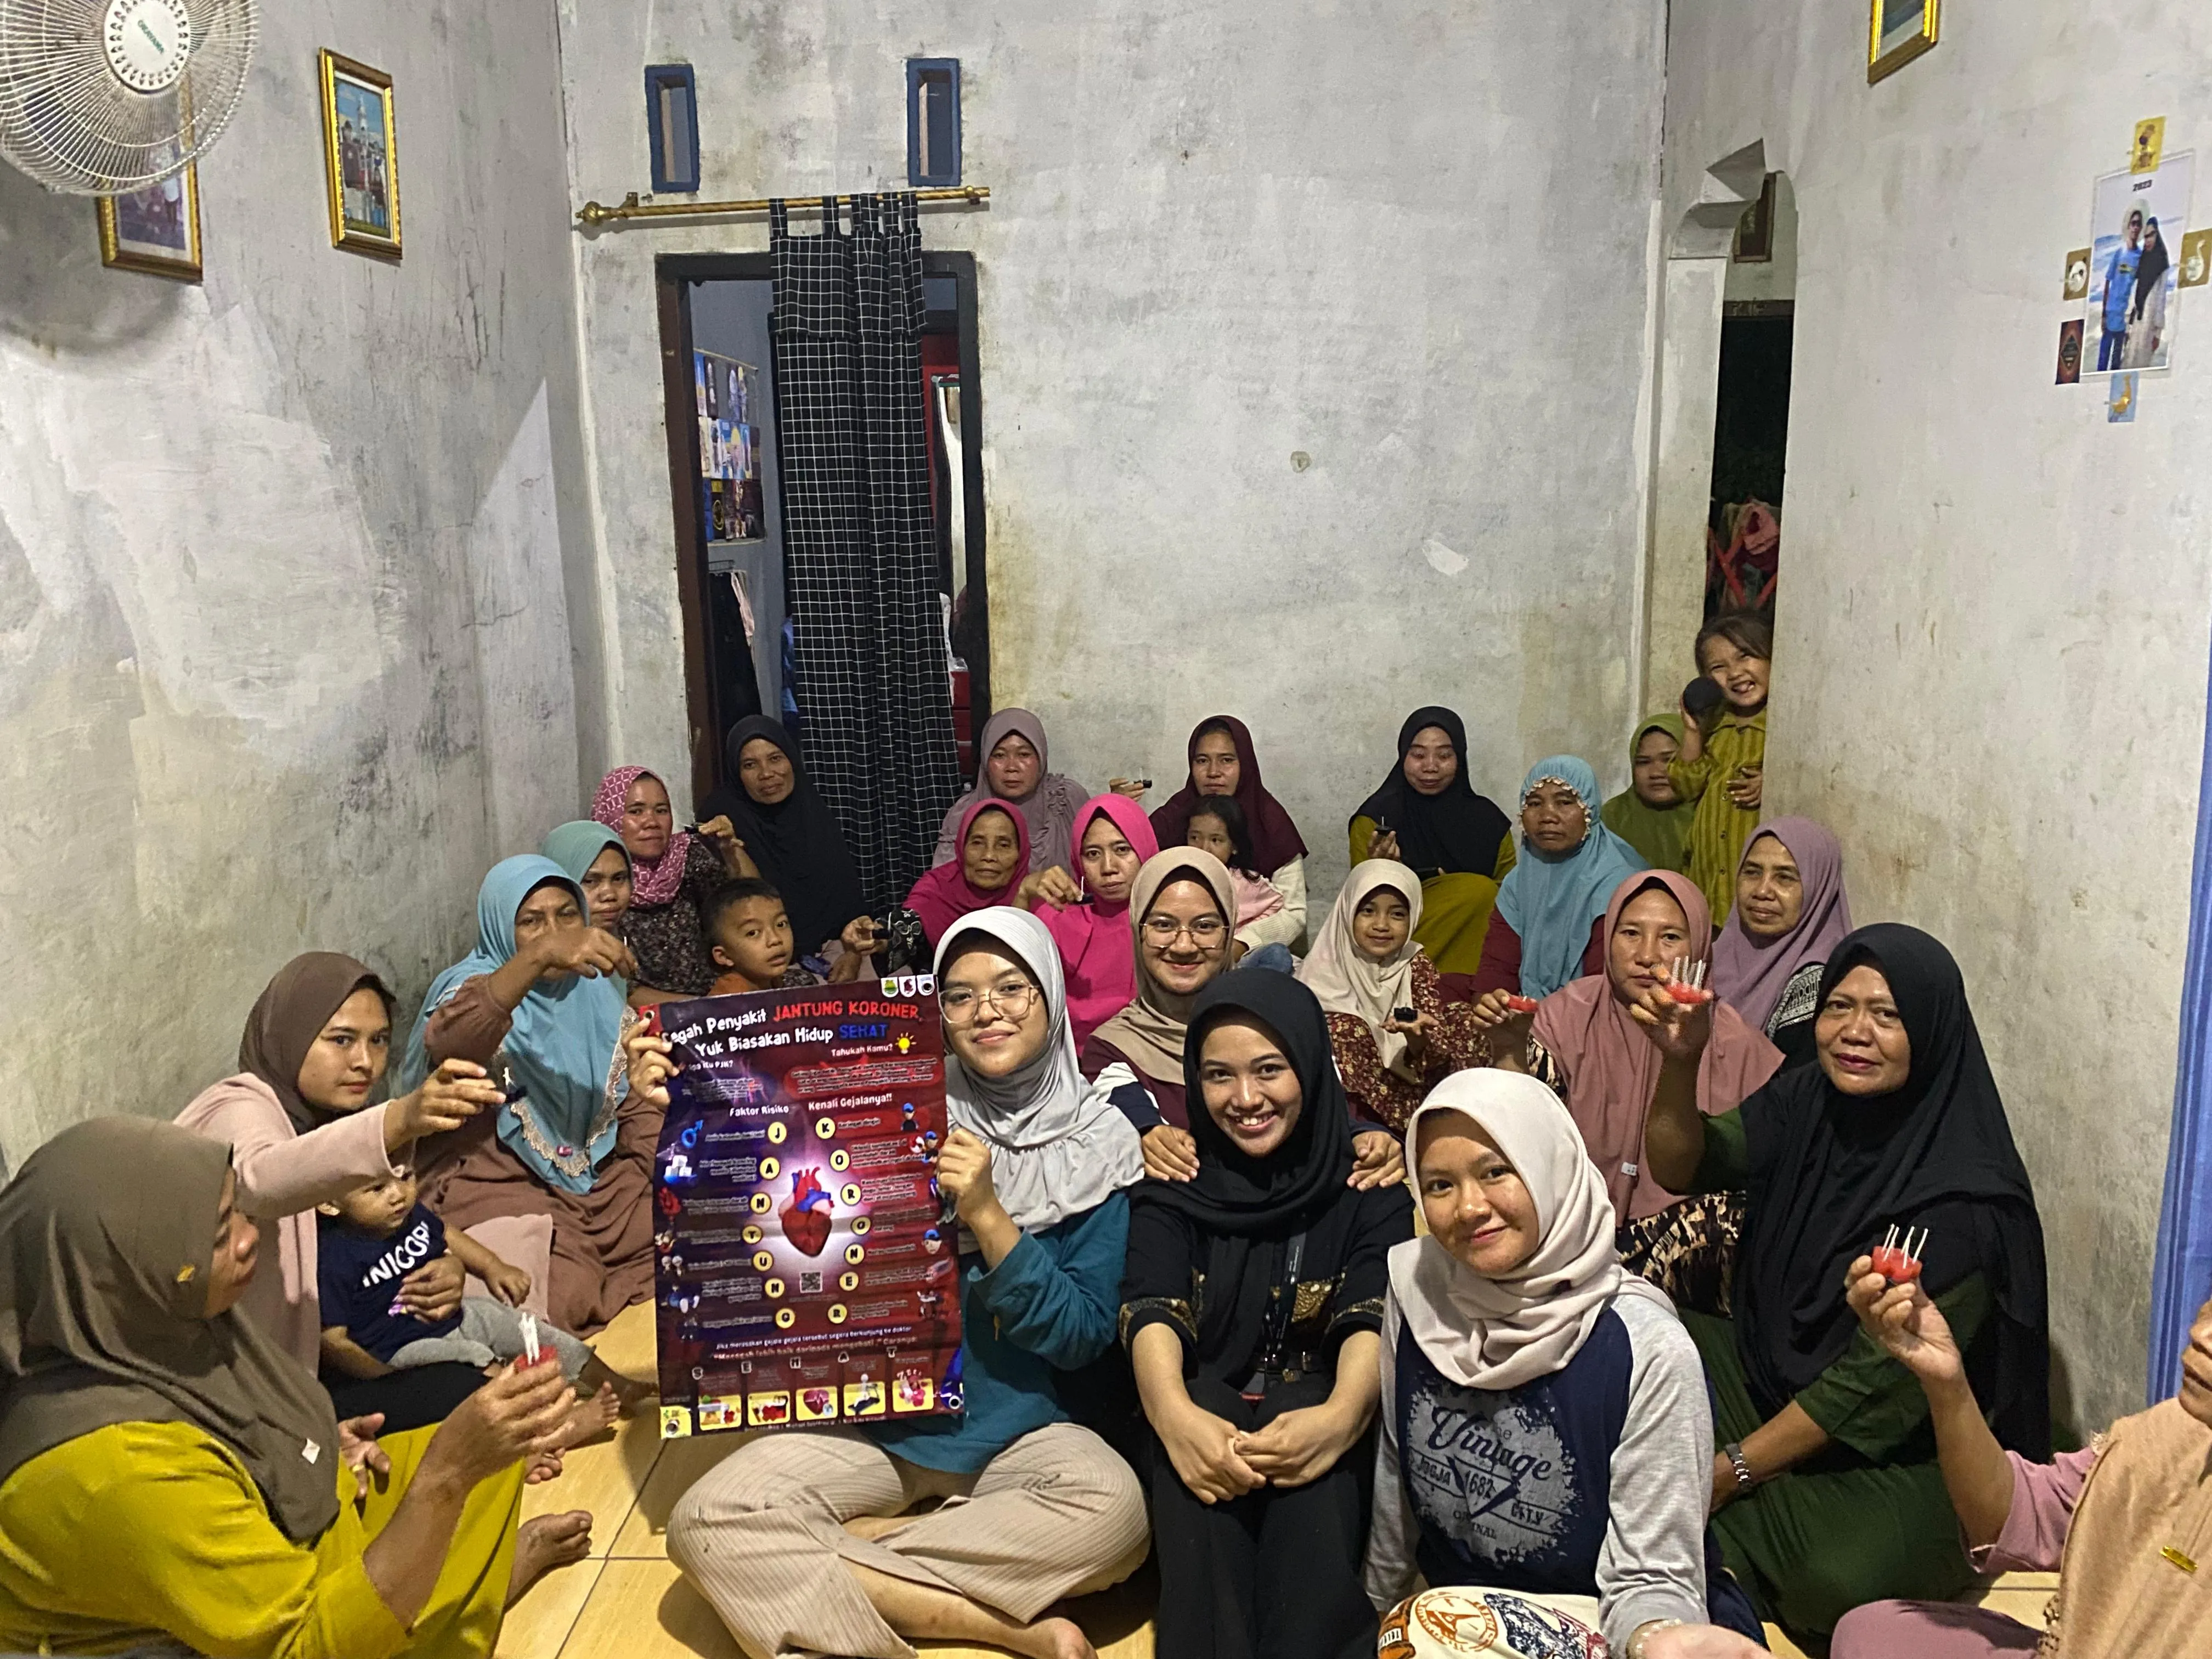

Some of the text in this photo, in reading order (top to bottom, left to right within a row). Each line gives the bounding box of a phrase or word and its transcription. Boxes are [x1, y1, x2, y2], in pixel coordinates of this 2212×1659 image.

[706, 1008, 767, 1034] Penyakit
[772, 1000, 843, 1022] JANTUNG
[695, 1024, 889, 1057] Yuk Biasakan Hidup SEHAT
[831, 1043, 893, 1057] Tahukah Kamu?
[715, 1059, 733, 1068] PJK?
[808, 1093, 893, 1111] Kenali Gejalanya!!
[730, 1104, 789, 1117] Faktor Risiko
